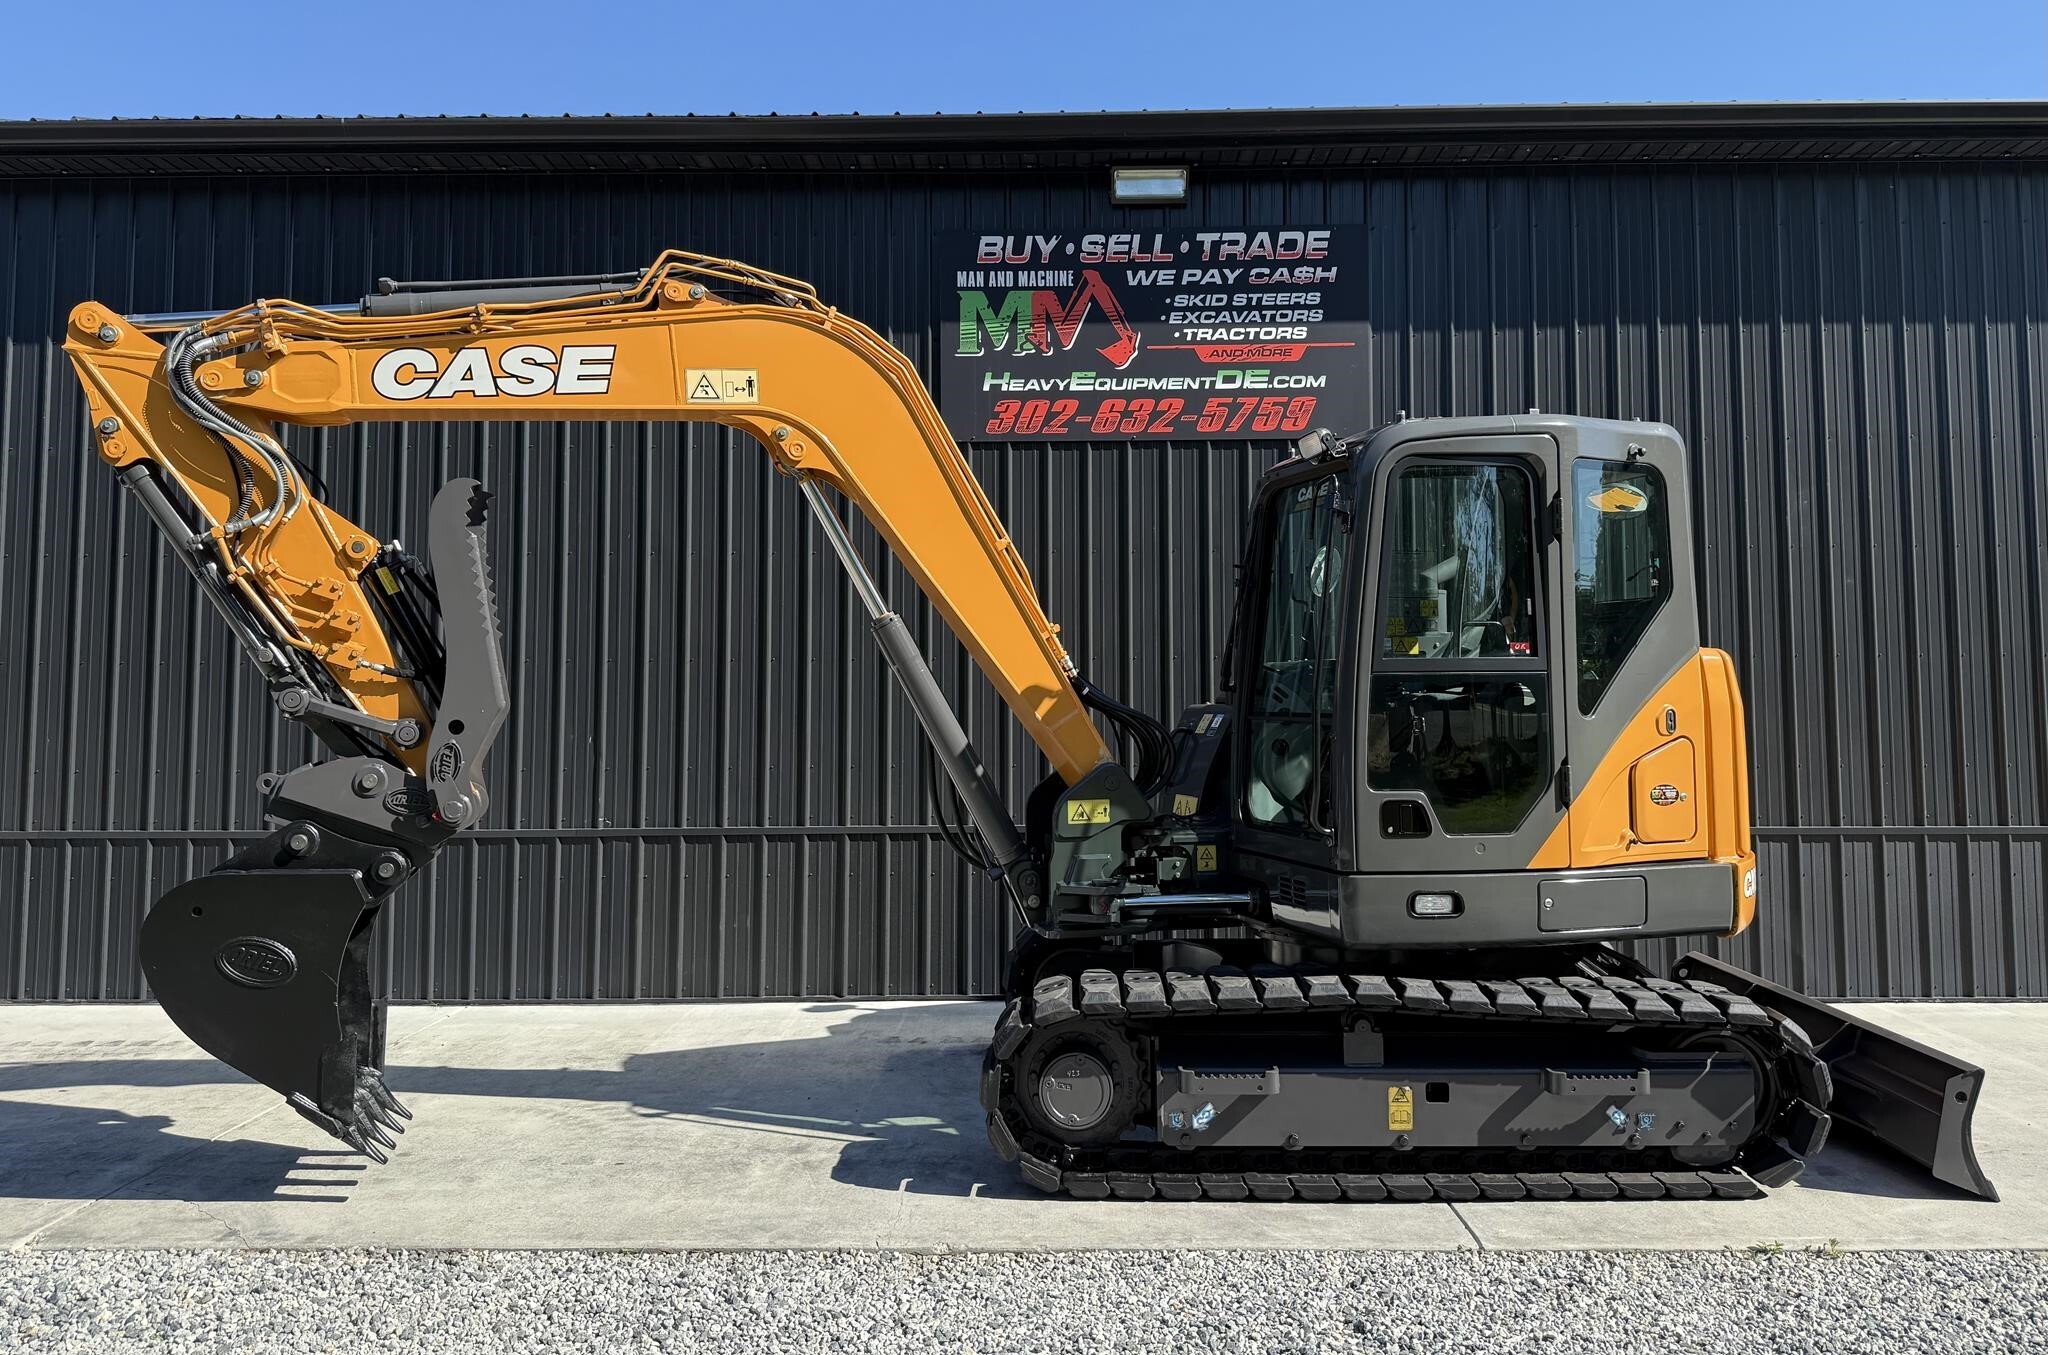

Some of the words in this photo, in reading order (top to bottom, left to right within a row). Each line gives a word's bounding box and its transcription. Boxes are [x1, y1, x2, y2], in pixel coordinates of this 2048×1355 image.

[976, 235, 1062, 264] BUY
[1079, 233, 1174, 264] SELL
[1196, 230, 1331, 262] TRADE
[957, 271, 985, 288] MAN
[988, 270, 1014, 288] AND
[1018, 269, 1074, 287] MACHINE
[1126, 269, 1177, 286] WE
[1181, 268, 1244, 286] PAY
[1173, 293, 1228, 307] SKID
[1232, 292, 1322, 306] STEERS
[1168, 309, 1324, 324] EXCAVATORS
[1183, 326, 1308, 341] TRACTORS
[1209, 349, 1246, 358] AND
[1246, 347, 1293, 357] MORE
[371, 344, 617, 401] CASE
[985, 396, 1318, 434] 302-632-5759
[1297, 481, 1330, 502] CAE
